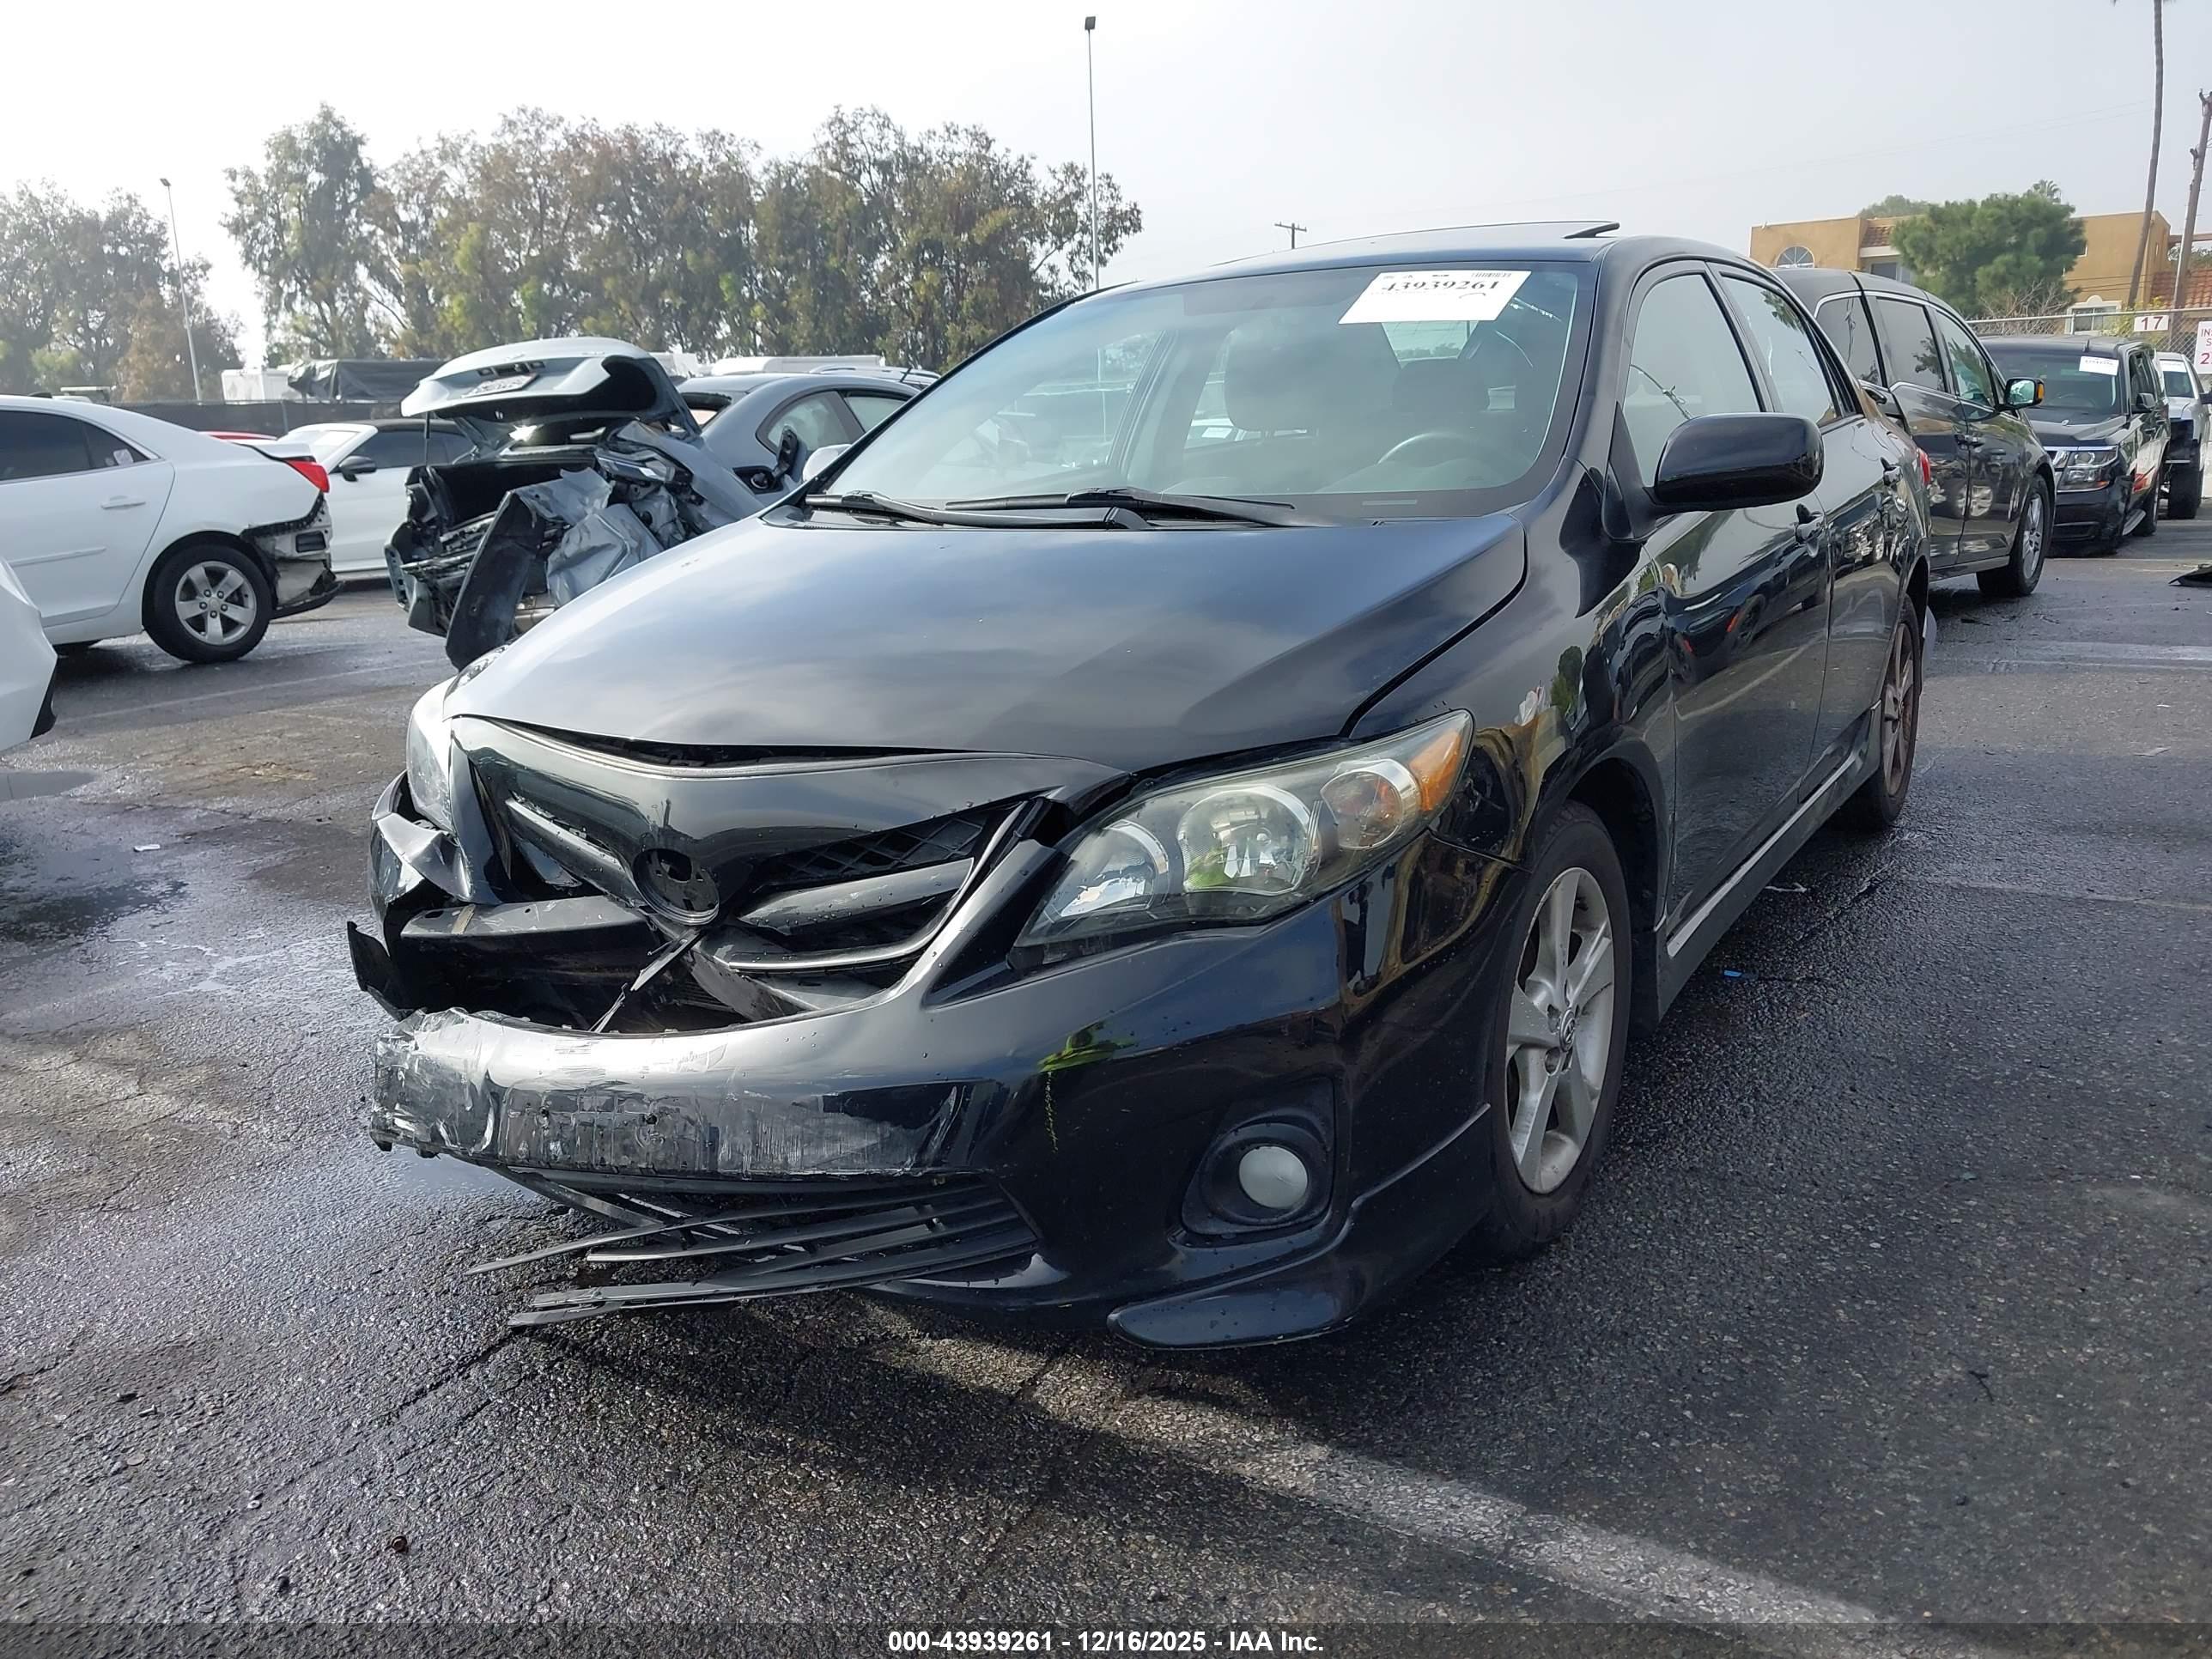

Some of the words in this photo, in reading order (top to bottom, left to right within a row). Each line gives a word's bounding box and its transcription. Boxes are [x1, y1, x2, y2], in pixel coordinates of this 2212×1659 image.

[1382, 280, 1499, 291] 43939261
[2142, 315, 2164, 331] 17
[2200, 328, 2212, 337] IN
